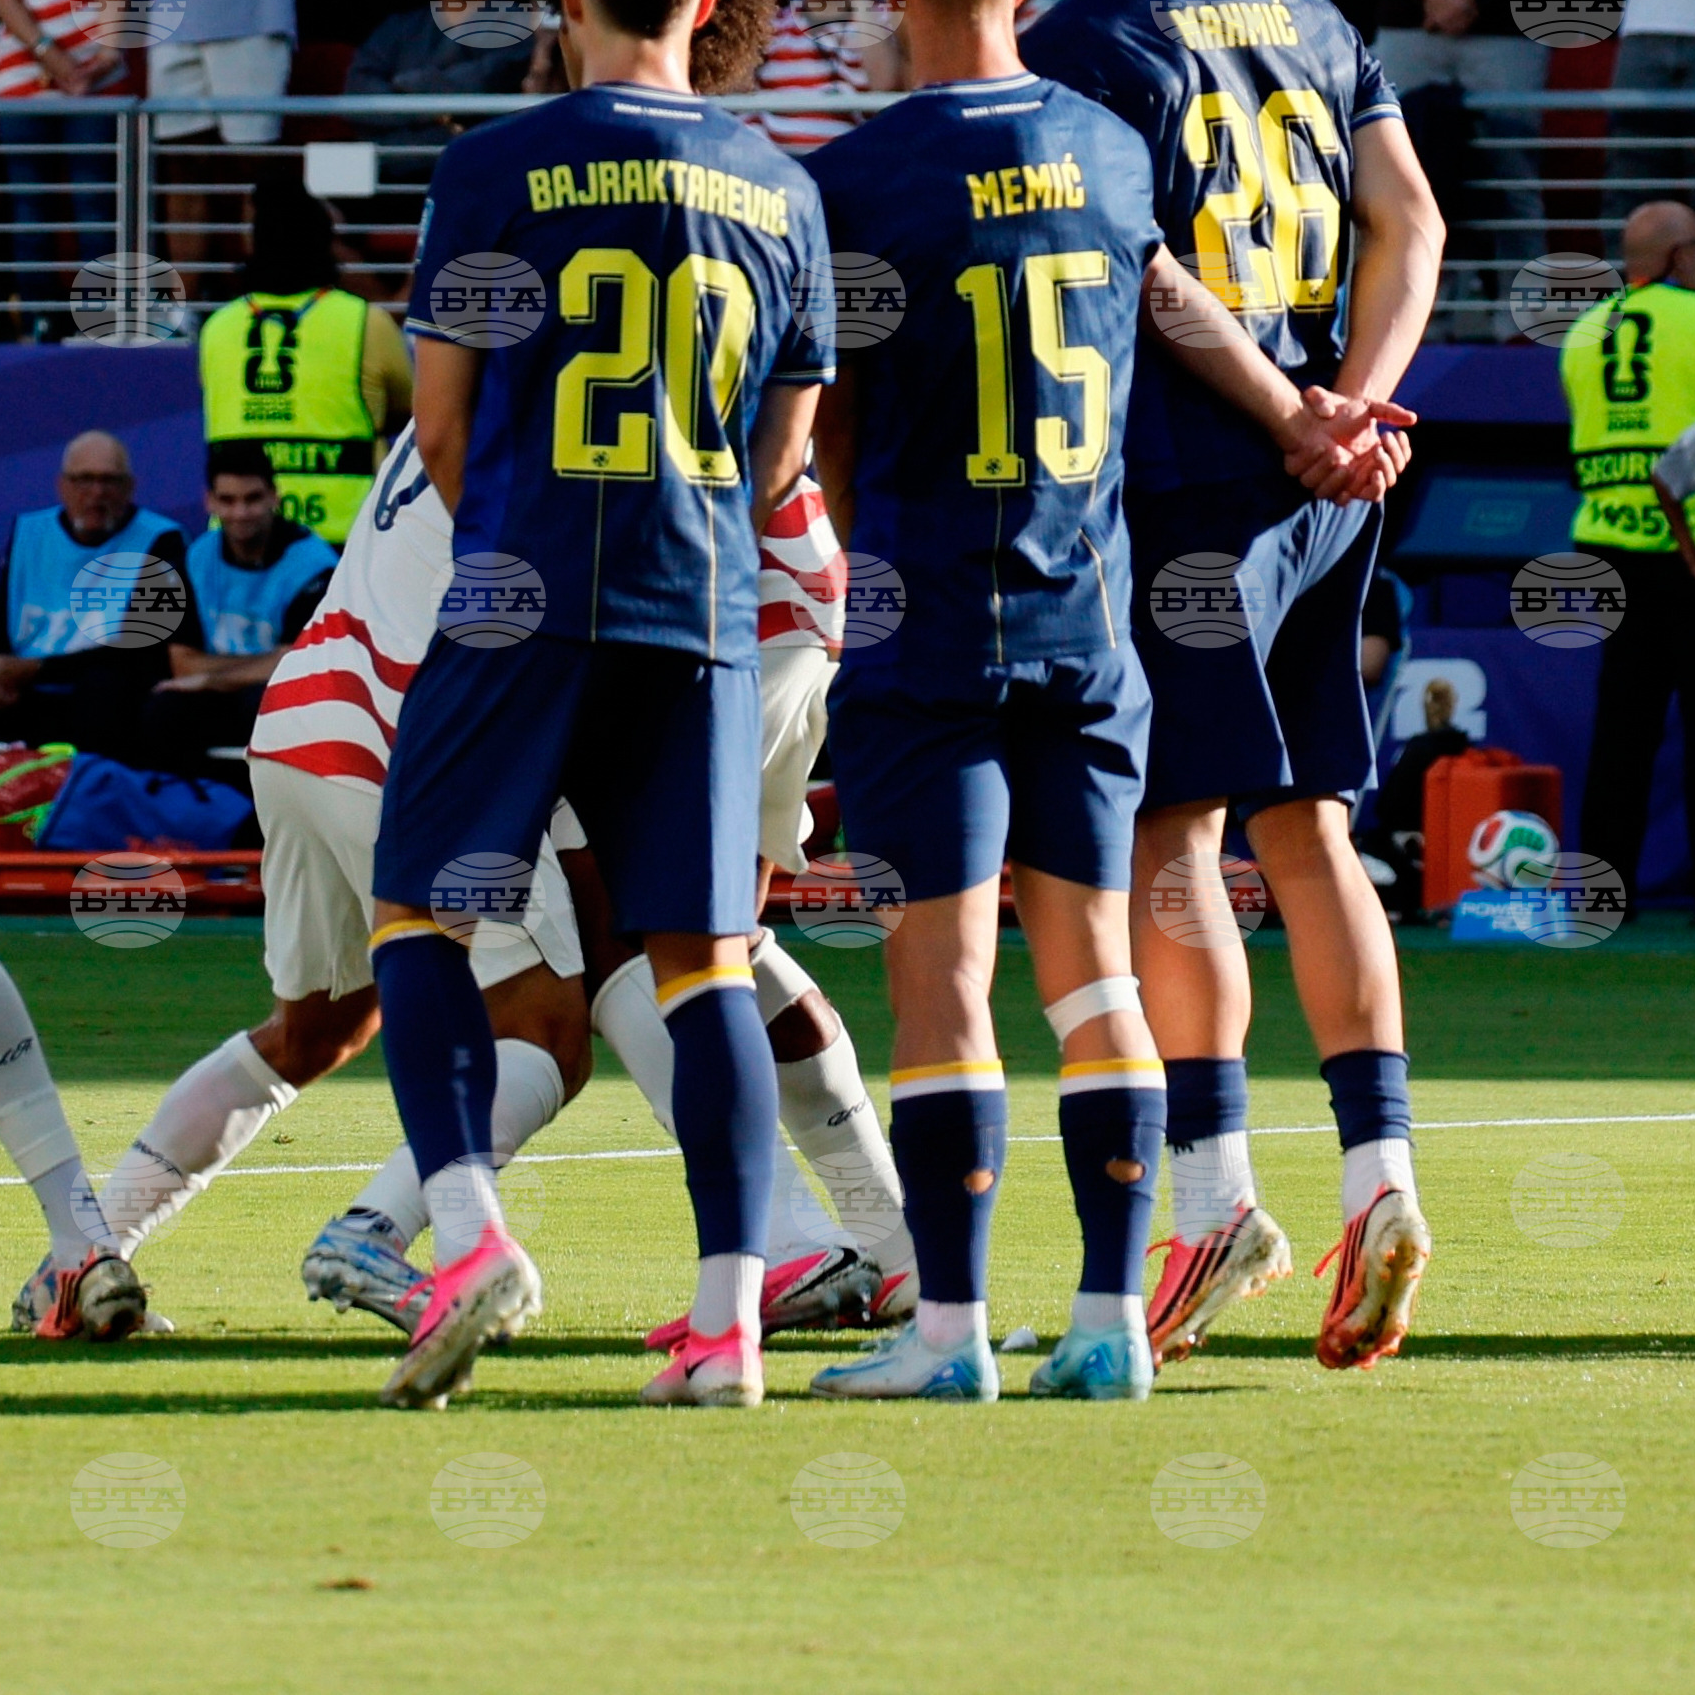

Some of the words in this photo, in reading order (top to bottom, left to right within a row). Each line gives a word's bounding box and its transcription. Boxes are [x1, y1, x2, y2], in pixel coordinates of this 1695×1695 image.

[527, 159, 790, 237] BAJRAKTAREVIĆ
[966, 152, 1085, 220] MEMIĆ
[1182, 88, 1342, 315] 26
[551, 248, 758, 488] 20
[955, 251, 1112, 489] 15
